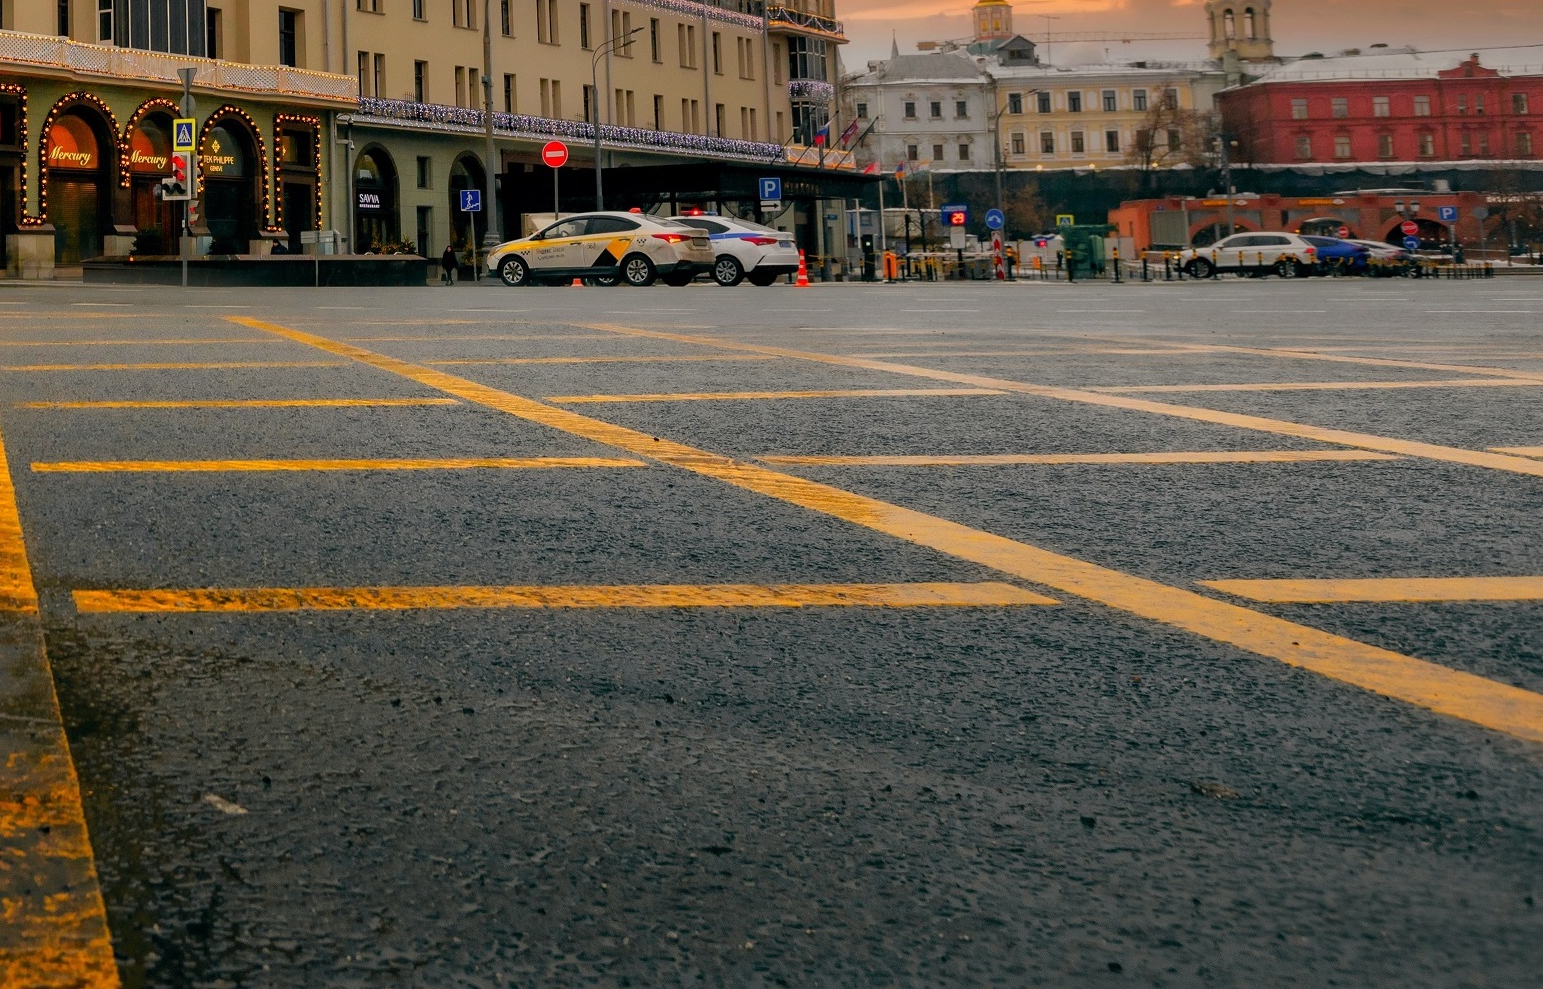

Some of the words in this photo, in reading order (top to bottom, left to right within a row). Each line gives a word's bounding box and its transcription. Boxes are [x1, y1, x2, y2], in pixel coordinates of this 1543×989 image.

[48, 146, 92, 166] Mercury
[130, 149, 168, 169] Mercury
[213, 155, 235, 165] PHILIPPE
[764, 180, 776, 198] P
[359, 193, 380, 204] SAVVA
[1442, 207, 1453, 219] P
